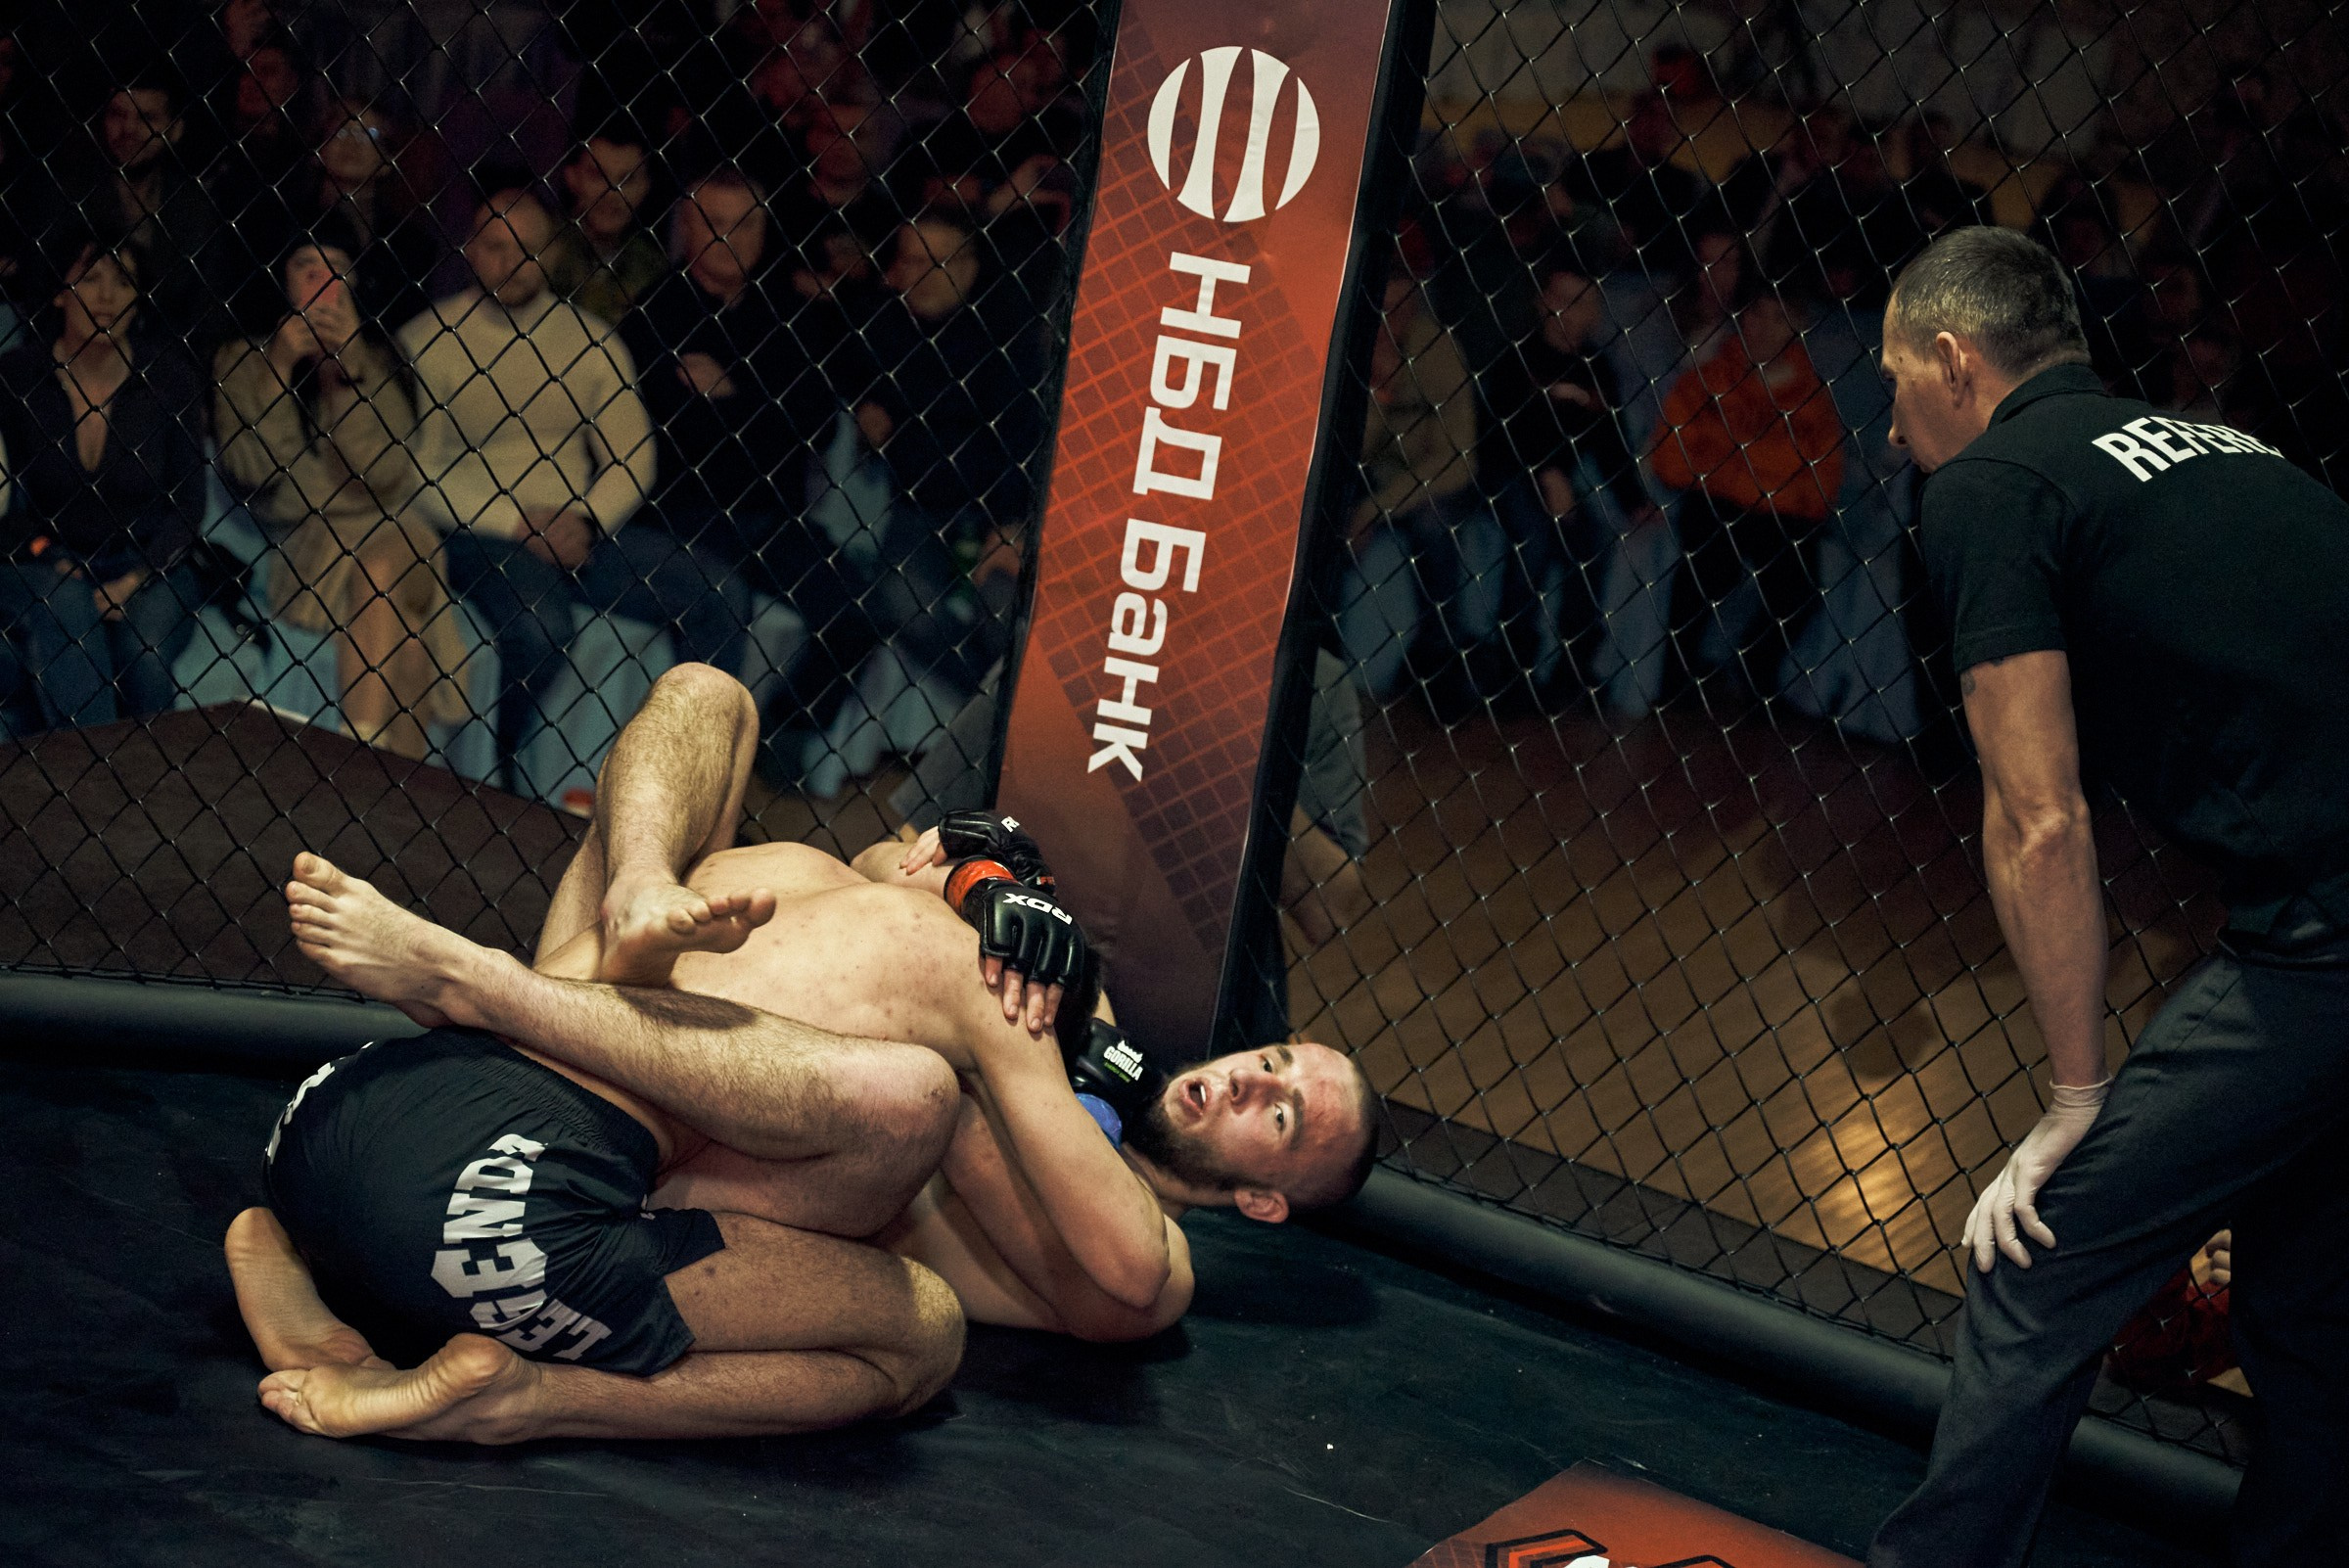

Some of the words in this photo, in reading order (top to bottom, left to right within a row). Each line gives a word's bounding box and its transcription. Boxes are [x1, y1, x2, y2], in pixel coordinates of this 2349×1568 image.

[1132, 251, 1251, 500] НБД
[2092, 416, 2285, 483] REFERE
[1087, 518, 1207, 782] Банк
[1002, 893, 1073, 925] RDX
[1103, 1045, 1144, 1082] GORILLA
